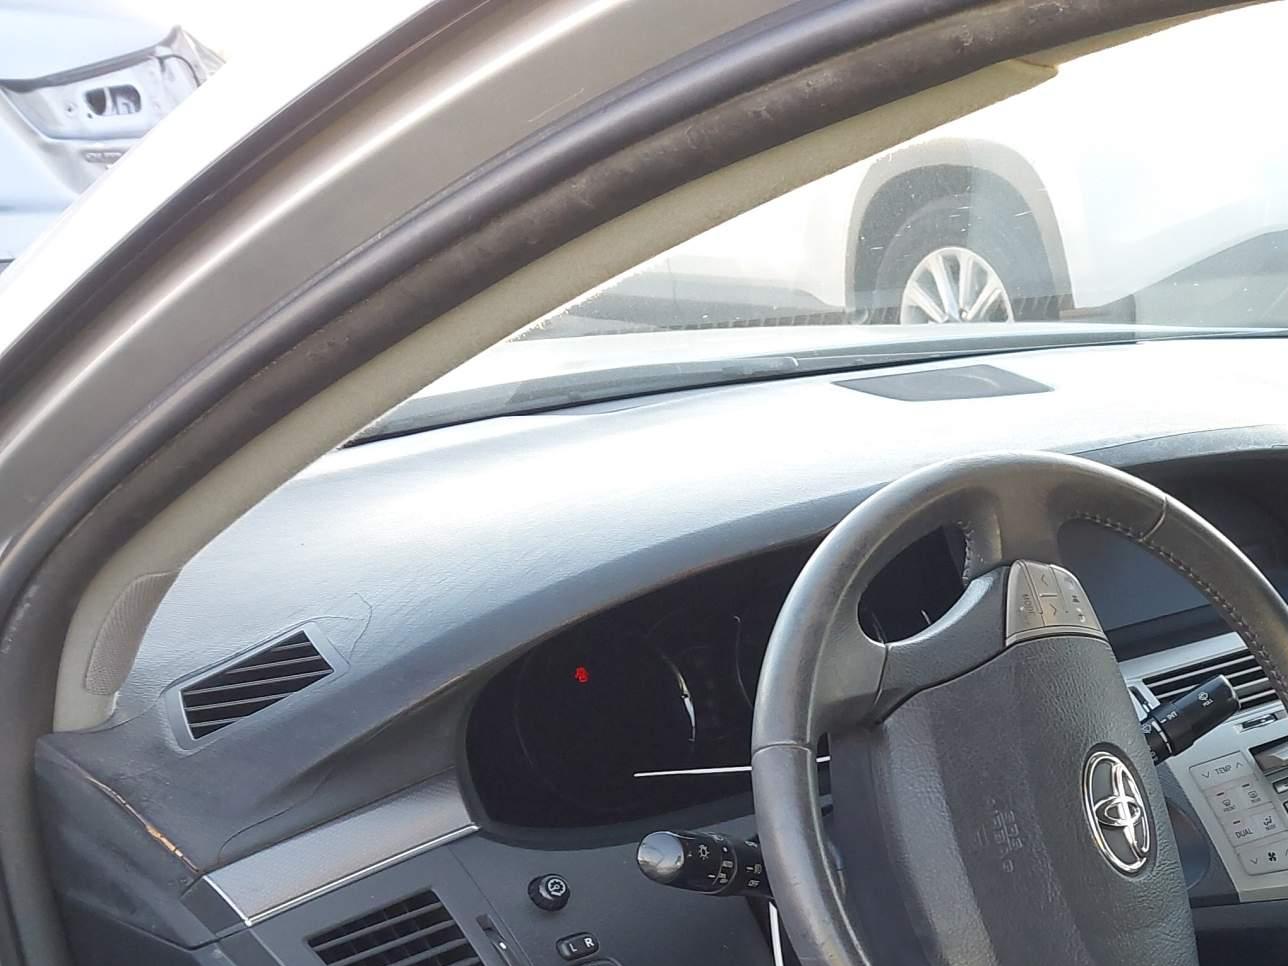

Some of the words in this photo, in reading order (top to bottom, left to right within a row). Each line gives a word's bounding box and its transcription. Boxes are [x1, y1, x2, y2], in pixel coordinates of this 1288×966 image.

[1235, 828, 1253, 839] DUAL
[569, 943, 577, 952] L
[584, 937, 594, 948] R
